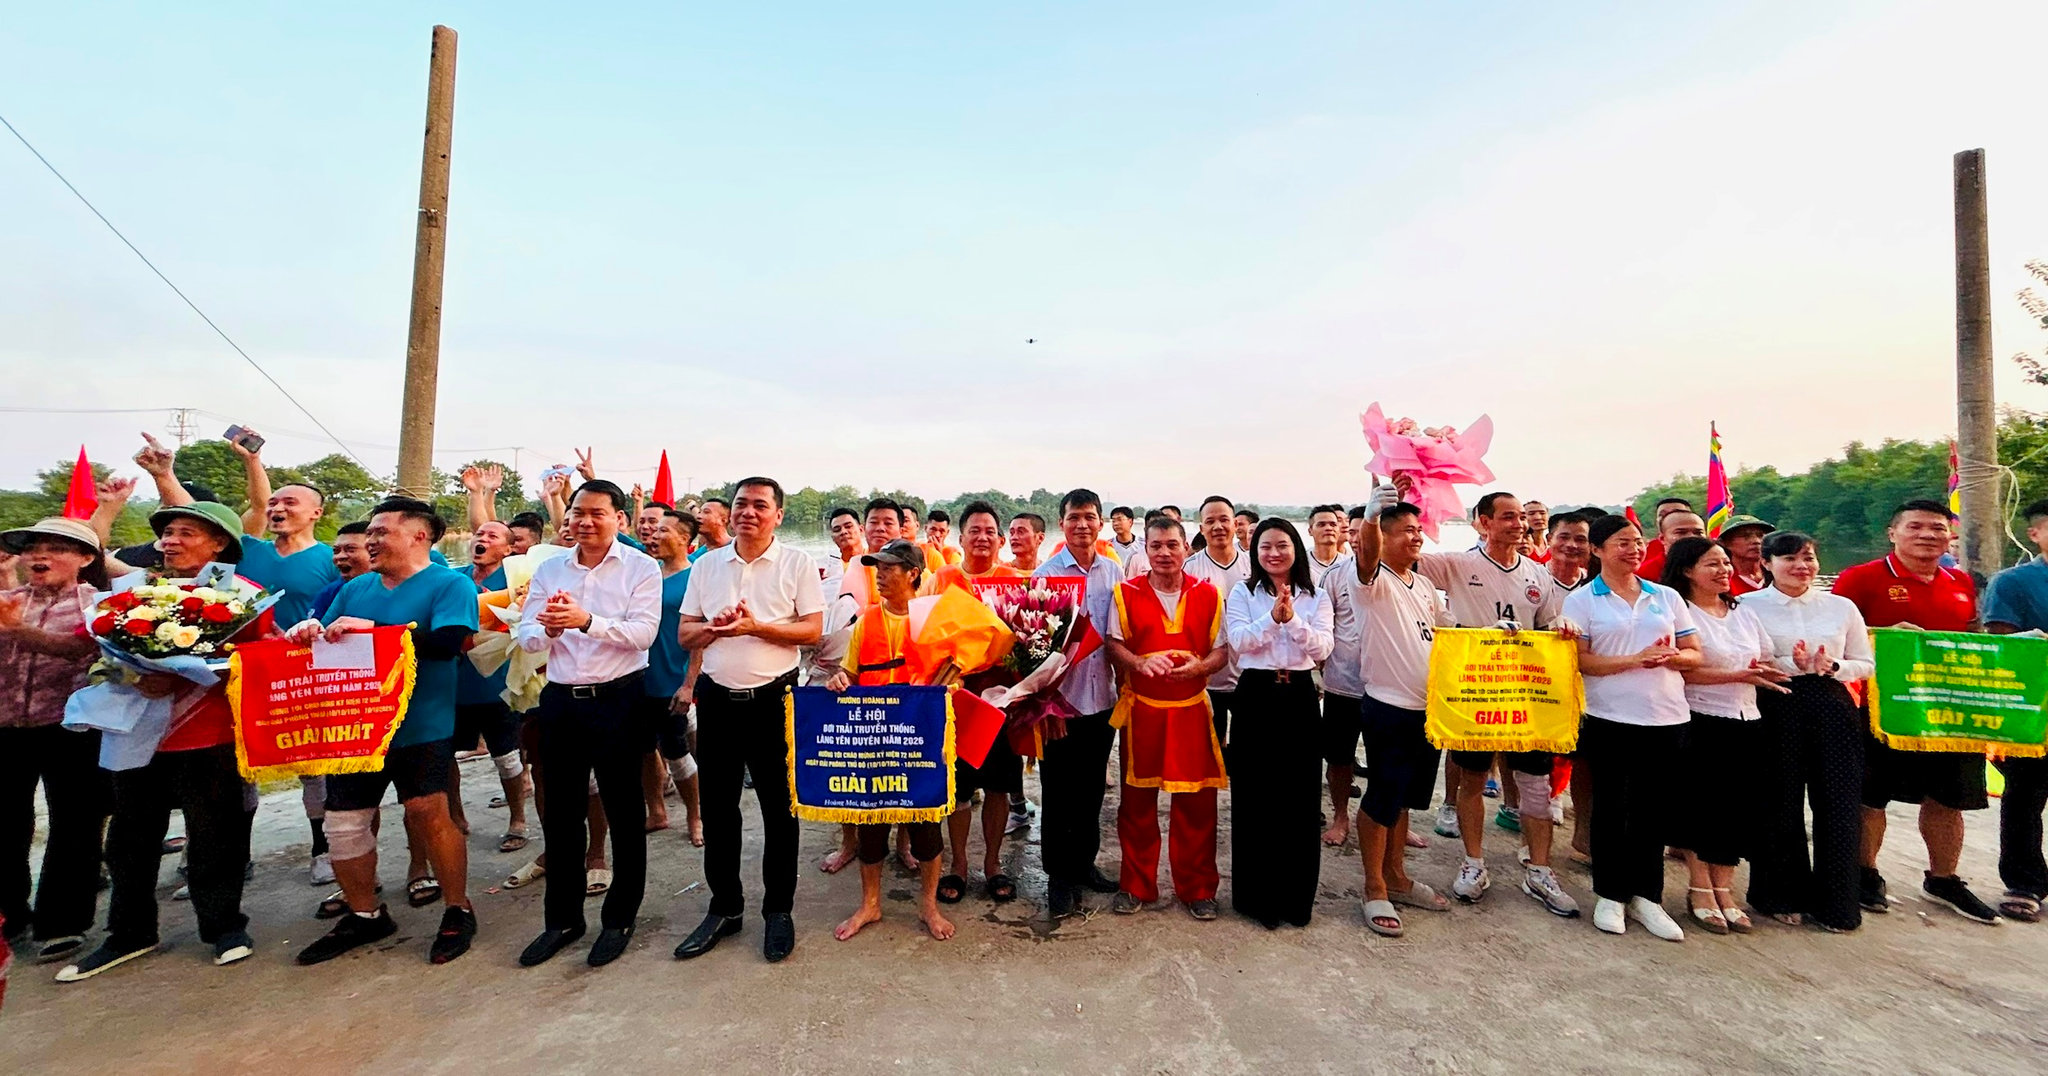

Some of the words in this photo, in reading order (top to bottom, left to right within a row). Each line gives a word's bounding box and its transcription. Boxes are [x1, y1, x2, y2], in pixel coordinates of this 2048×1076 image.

[1496, 601, 1515, 621] 14
[848, 706, 862, 721] LỄ
[864, 707, 886, 722] HỘI
[1475, 707, 1508, 724] GIẢI
[276, 724, 320, 750] GIẢI
[322, 718, 374, 743] NHẤT
[854, 722, 888, 734] TRUYỀN
[889, 722, 916, 734] THỐNG
[816, 734, 834, 744] LÀNG
[836, 735, 850, 745] YÊN
[852, 734, 880, 746] DUYÊN
[882, 735, 902, 745] NĂM
[903, 736, 924, 746] 2026
[828, 772, 867, 794] GIẢI
[872, 772, 908, 794] NHÌ
